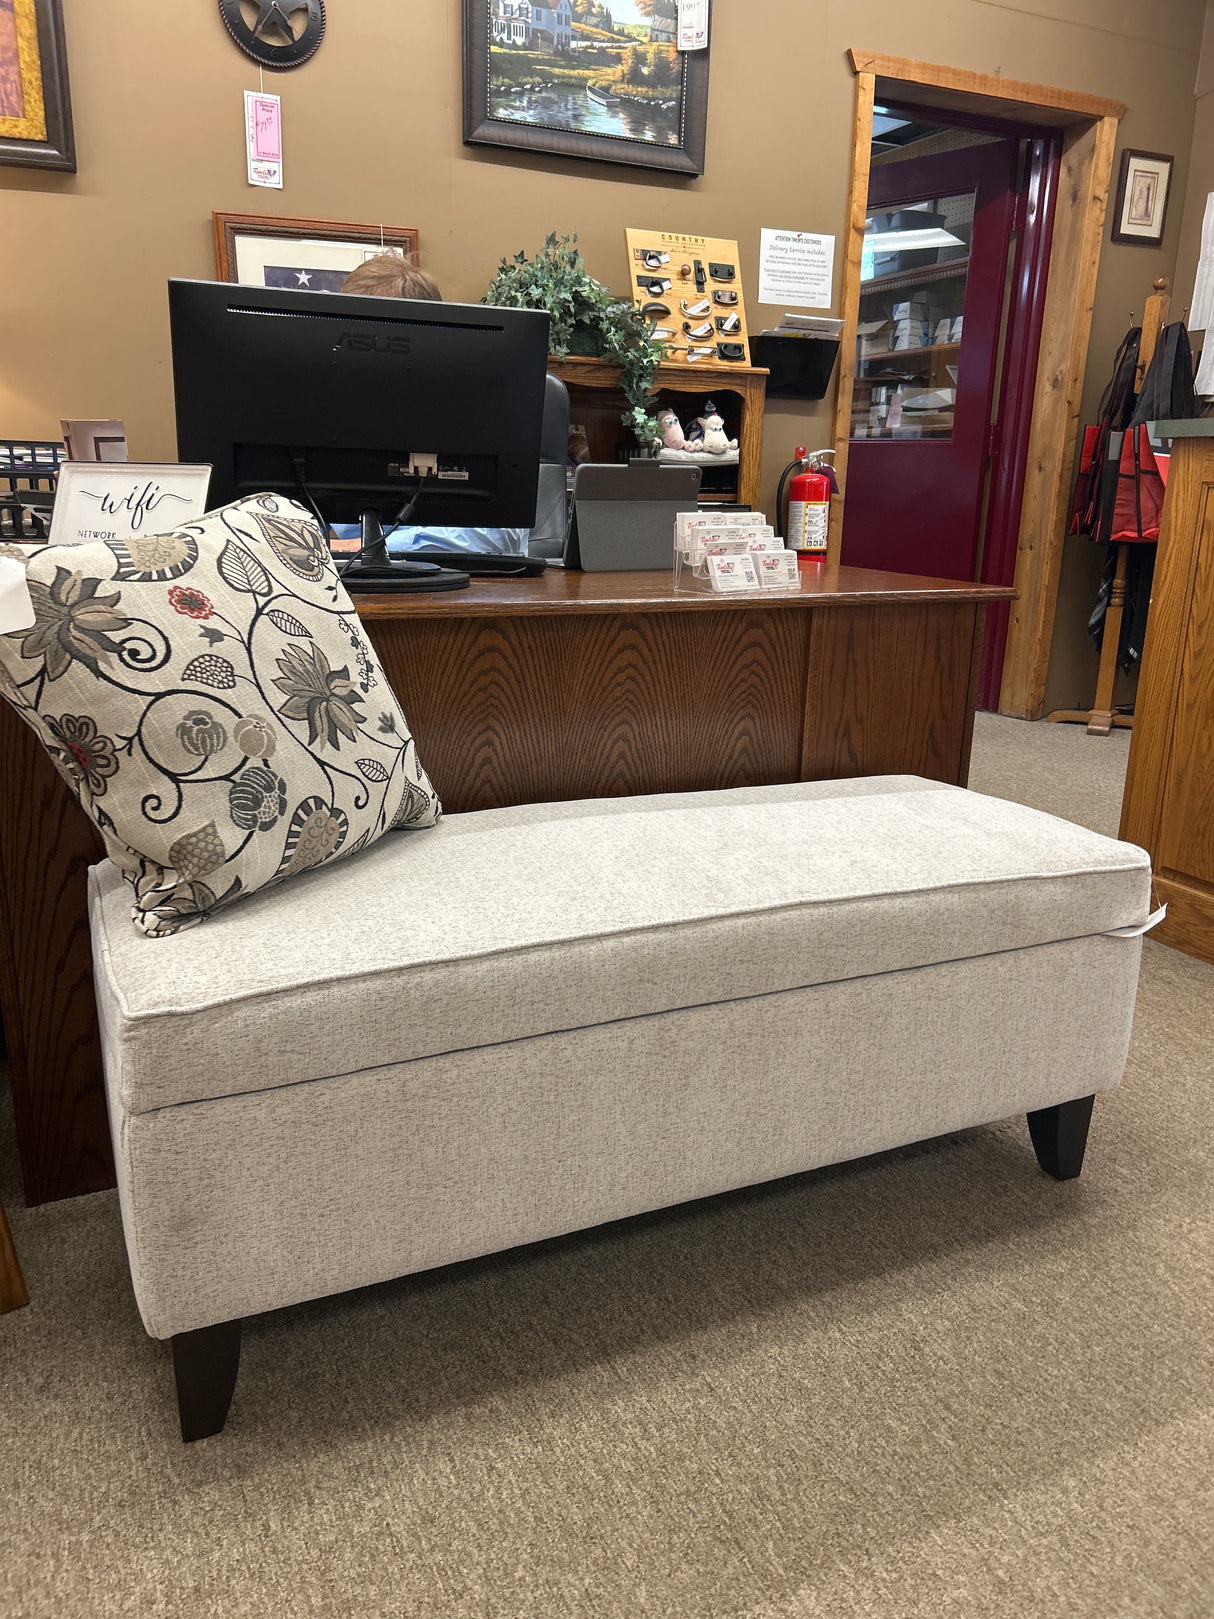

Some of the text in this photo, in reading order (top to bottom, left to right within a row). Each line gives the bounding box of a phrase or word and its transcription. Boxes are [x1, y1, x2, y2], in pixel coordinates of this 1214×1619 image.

[661, 234, 705, 245] COUNTRY
[769, 244, 788, 255] Delivery
[789, 245, 806, 254] Service
[335, 332, 412, 355] ASUS
[79, 480, 193, 530] wifi
[77, 529, 117, 540] NETWORK
